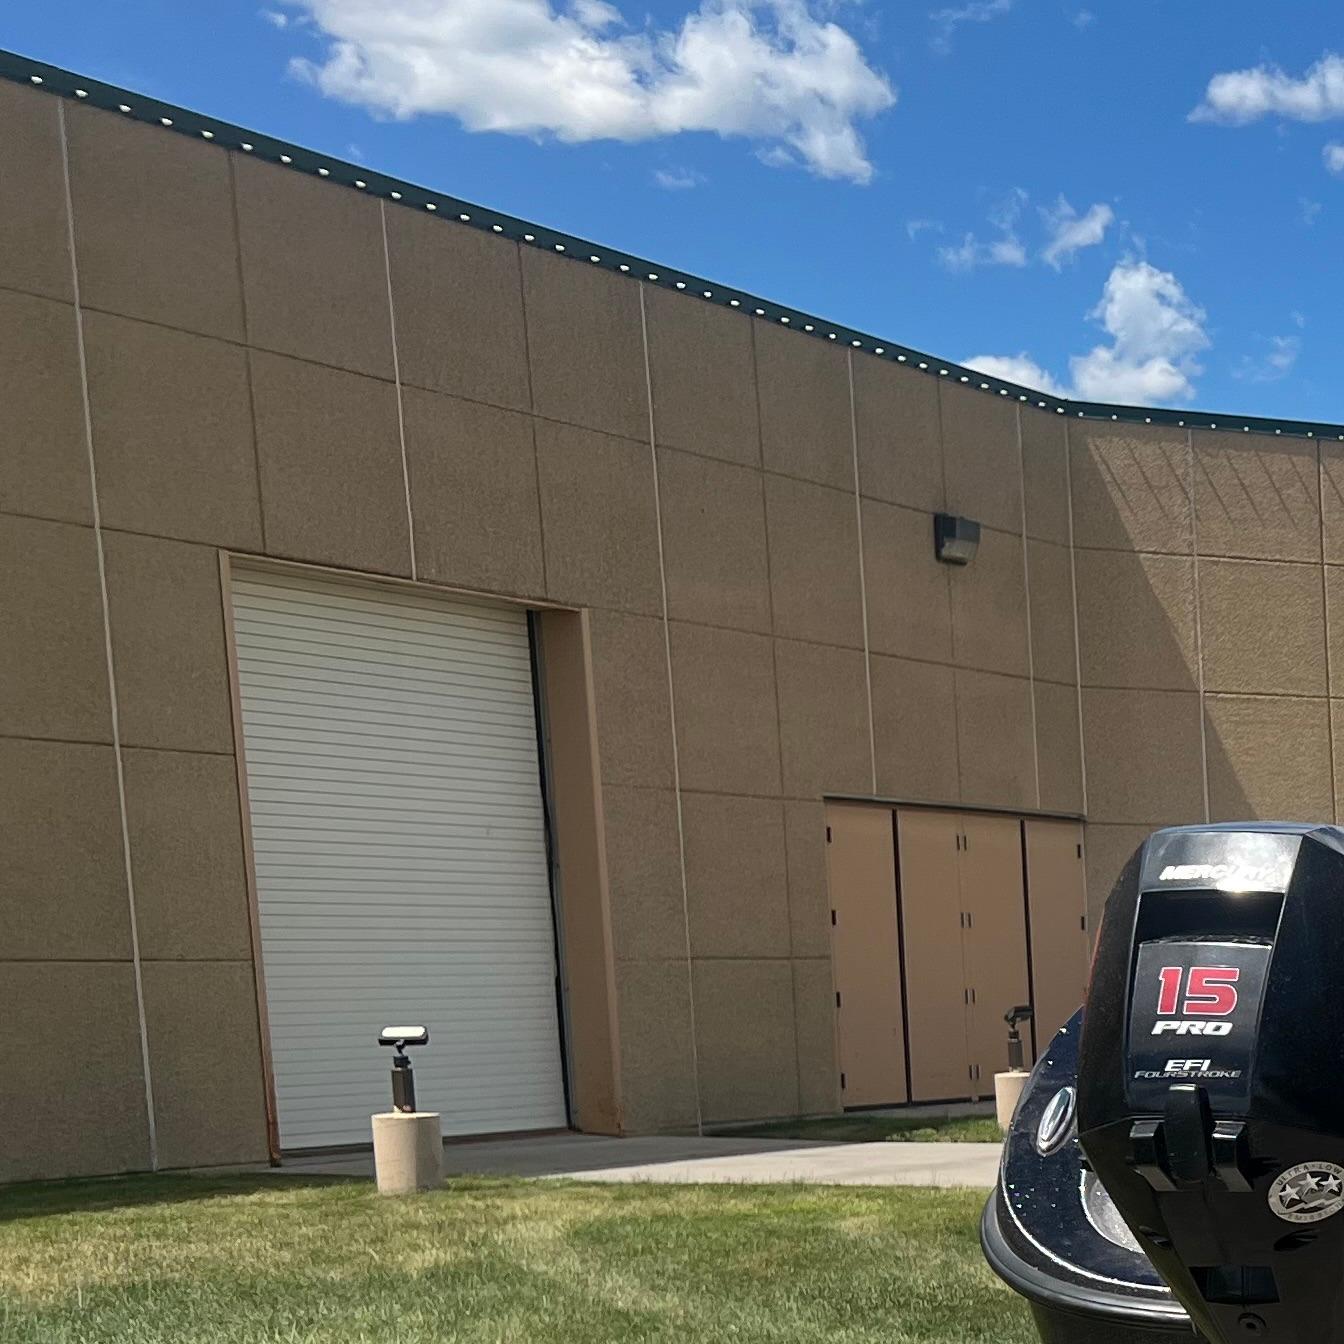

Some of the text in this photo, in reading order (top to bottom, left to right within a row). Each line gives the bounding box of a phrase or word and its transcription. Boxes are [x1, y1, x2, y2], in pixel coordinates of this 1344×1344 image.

[1157, 966, 1240, 1016] 15
[1151, 1020, 1234, 1036] PRO
[1164, 1059, 1212, 1072] EFI
[1134, 1070, 1242, 1079] FOURSTROKE
